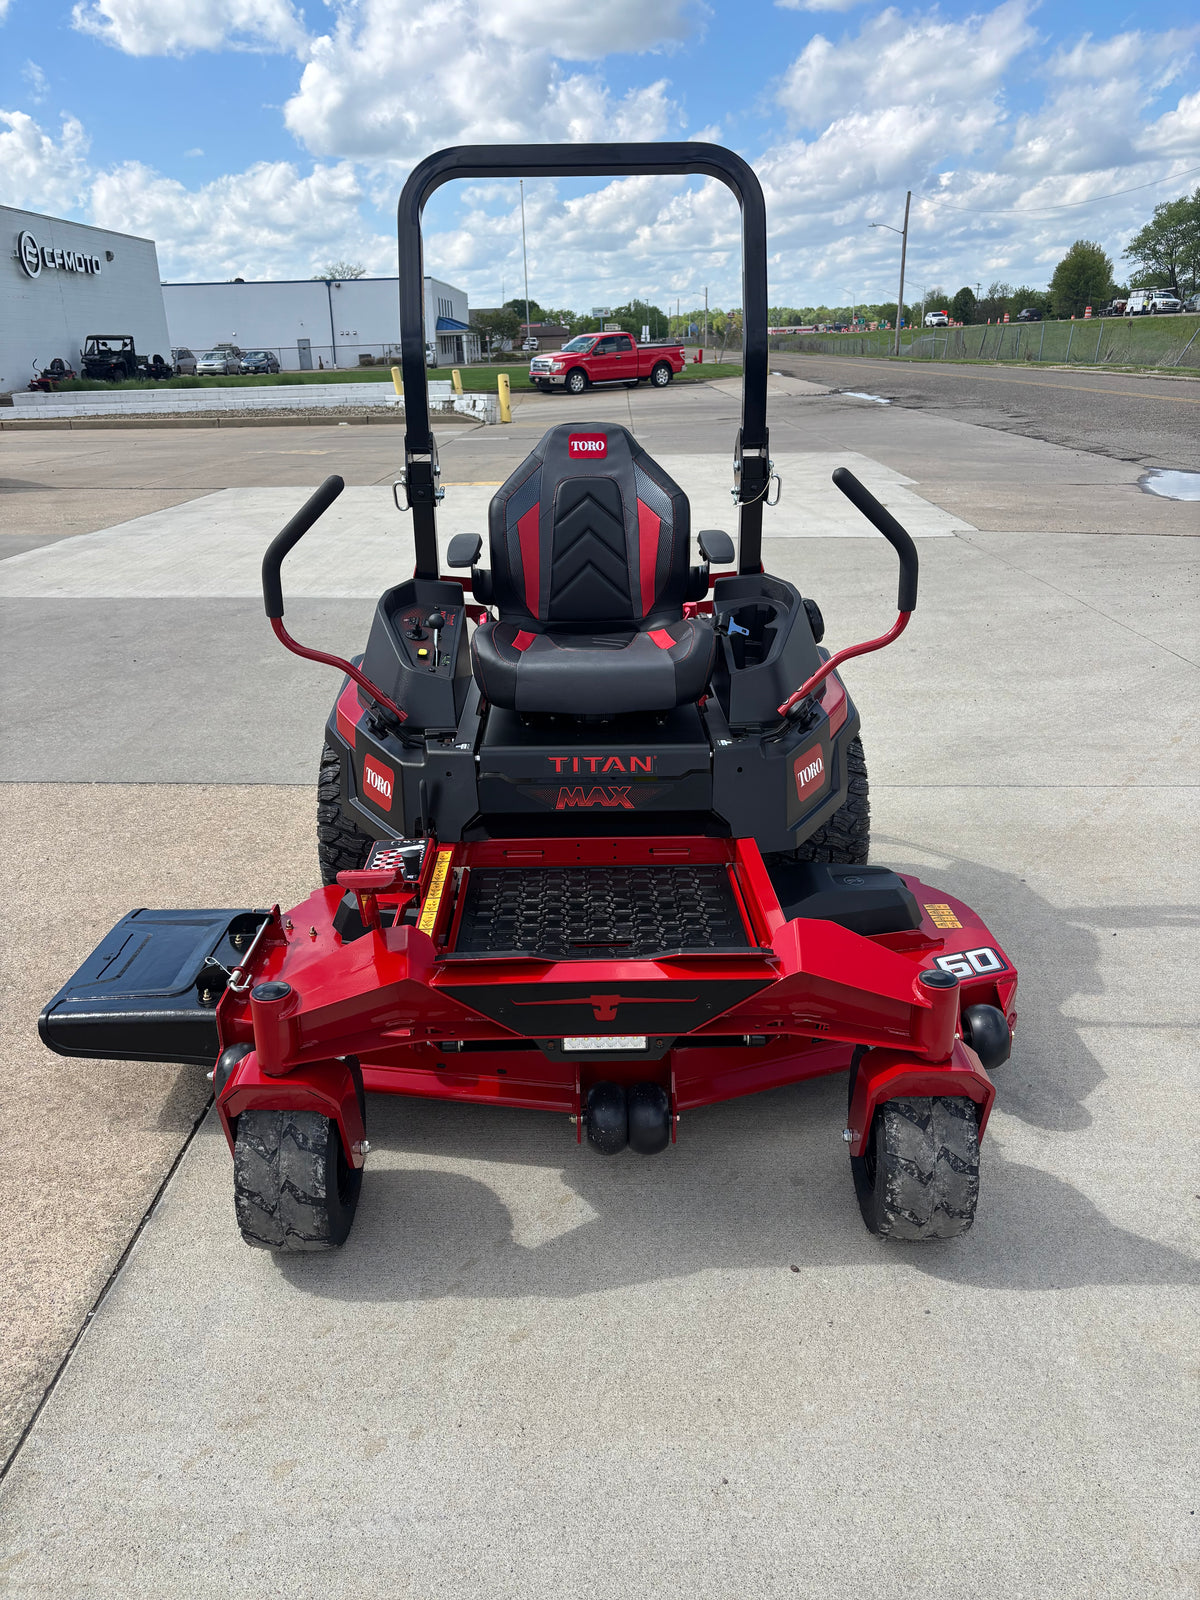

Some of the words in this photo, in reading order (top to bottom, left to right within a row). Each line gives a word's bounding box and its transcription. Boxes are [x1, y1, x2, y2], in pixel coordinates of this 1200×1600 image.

[42, 247, 101, 274] CFMOTO
[571, 440, 605, 451] TORO
[548, 756, 653, 773] TITAN
[798, 757, 823, 787] TORO
[366, 766, 391, 797] TORO
[555, 786, 635, 809] MAX
